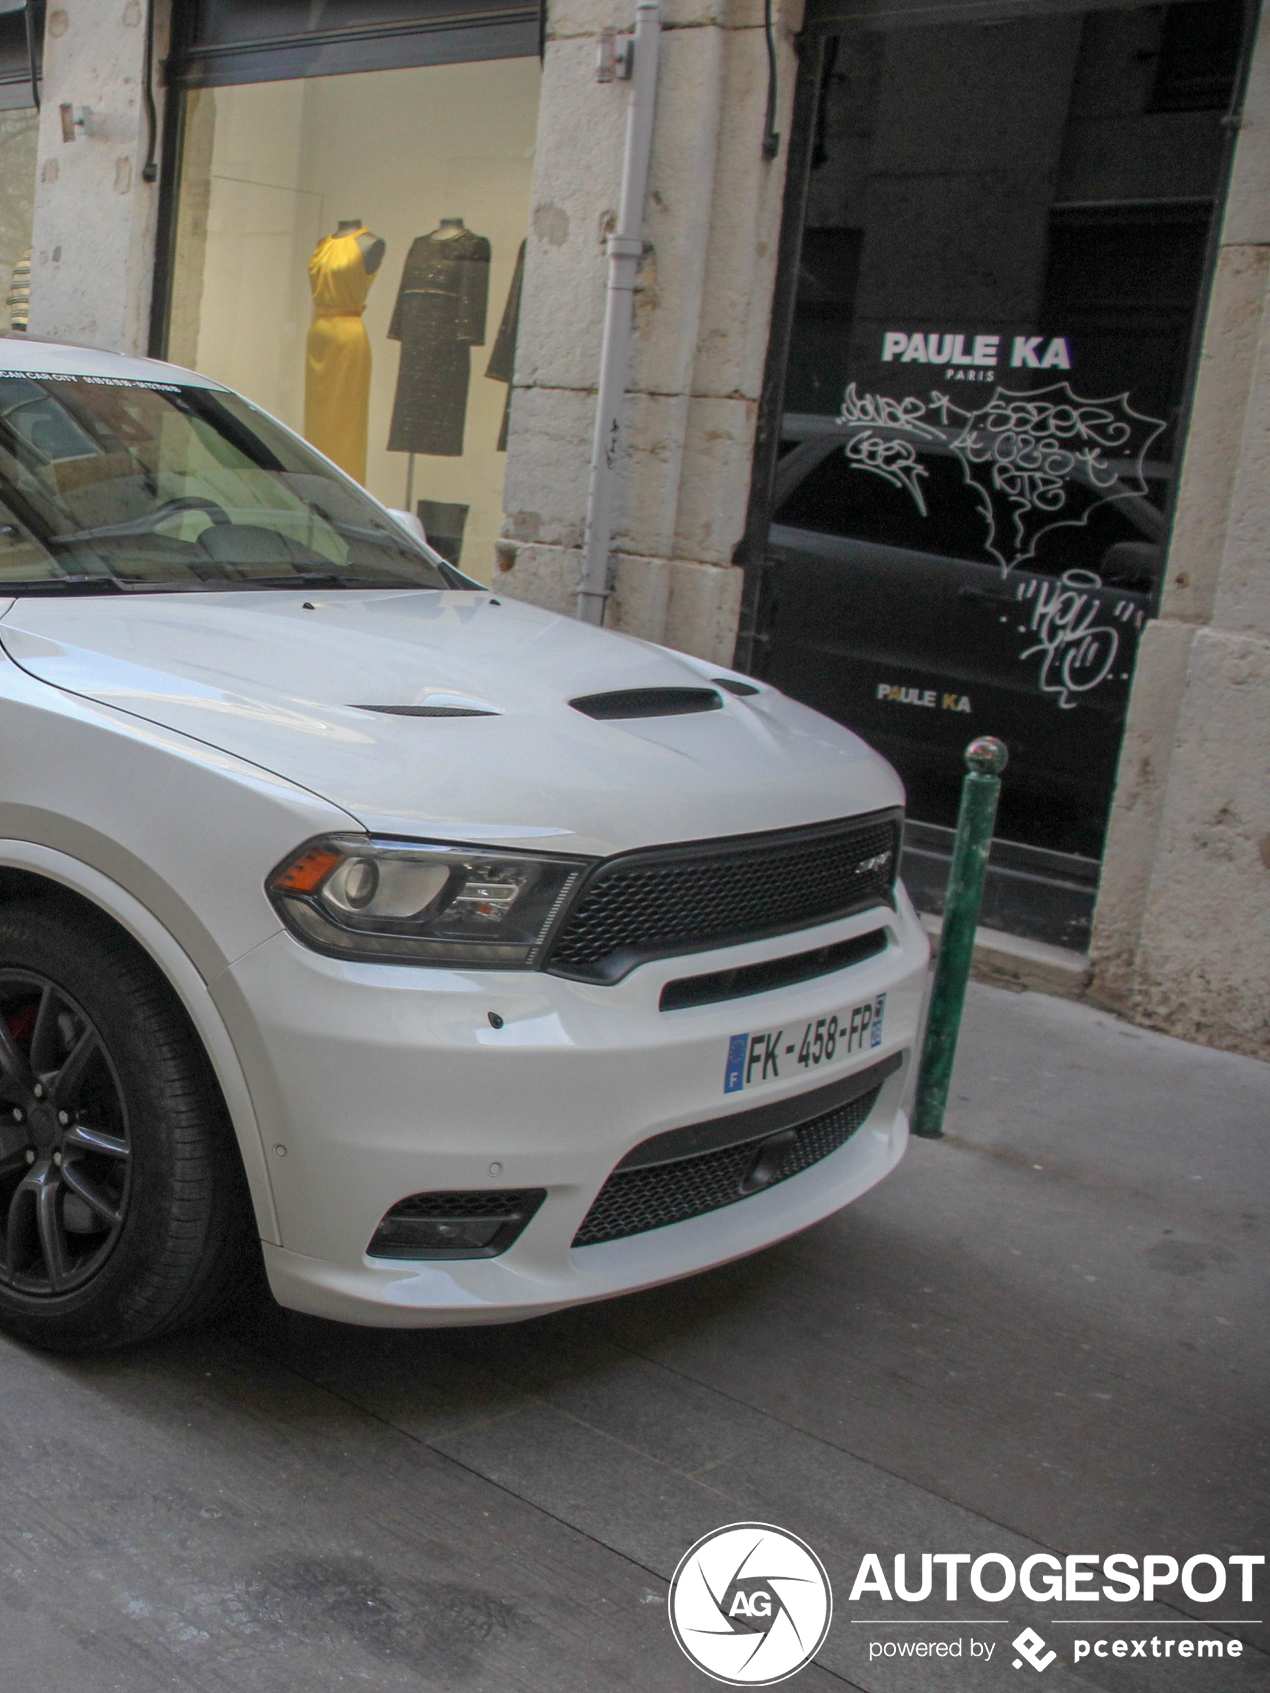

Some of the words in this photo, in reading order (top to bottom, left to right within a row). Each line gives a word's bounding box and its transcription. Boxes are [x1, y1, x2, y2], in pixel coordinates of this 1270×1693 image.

[881, 332, 1000, 366] PAULE
[1009, 336, 1071, 370] KA
[944, 368, 995, 382] PARIS
[876, 683, 937, 708] PAULE
[942, 693, 972, 714] KA
[746, 1003, 873, 1084] FK-458-FP
